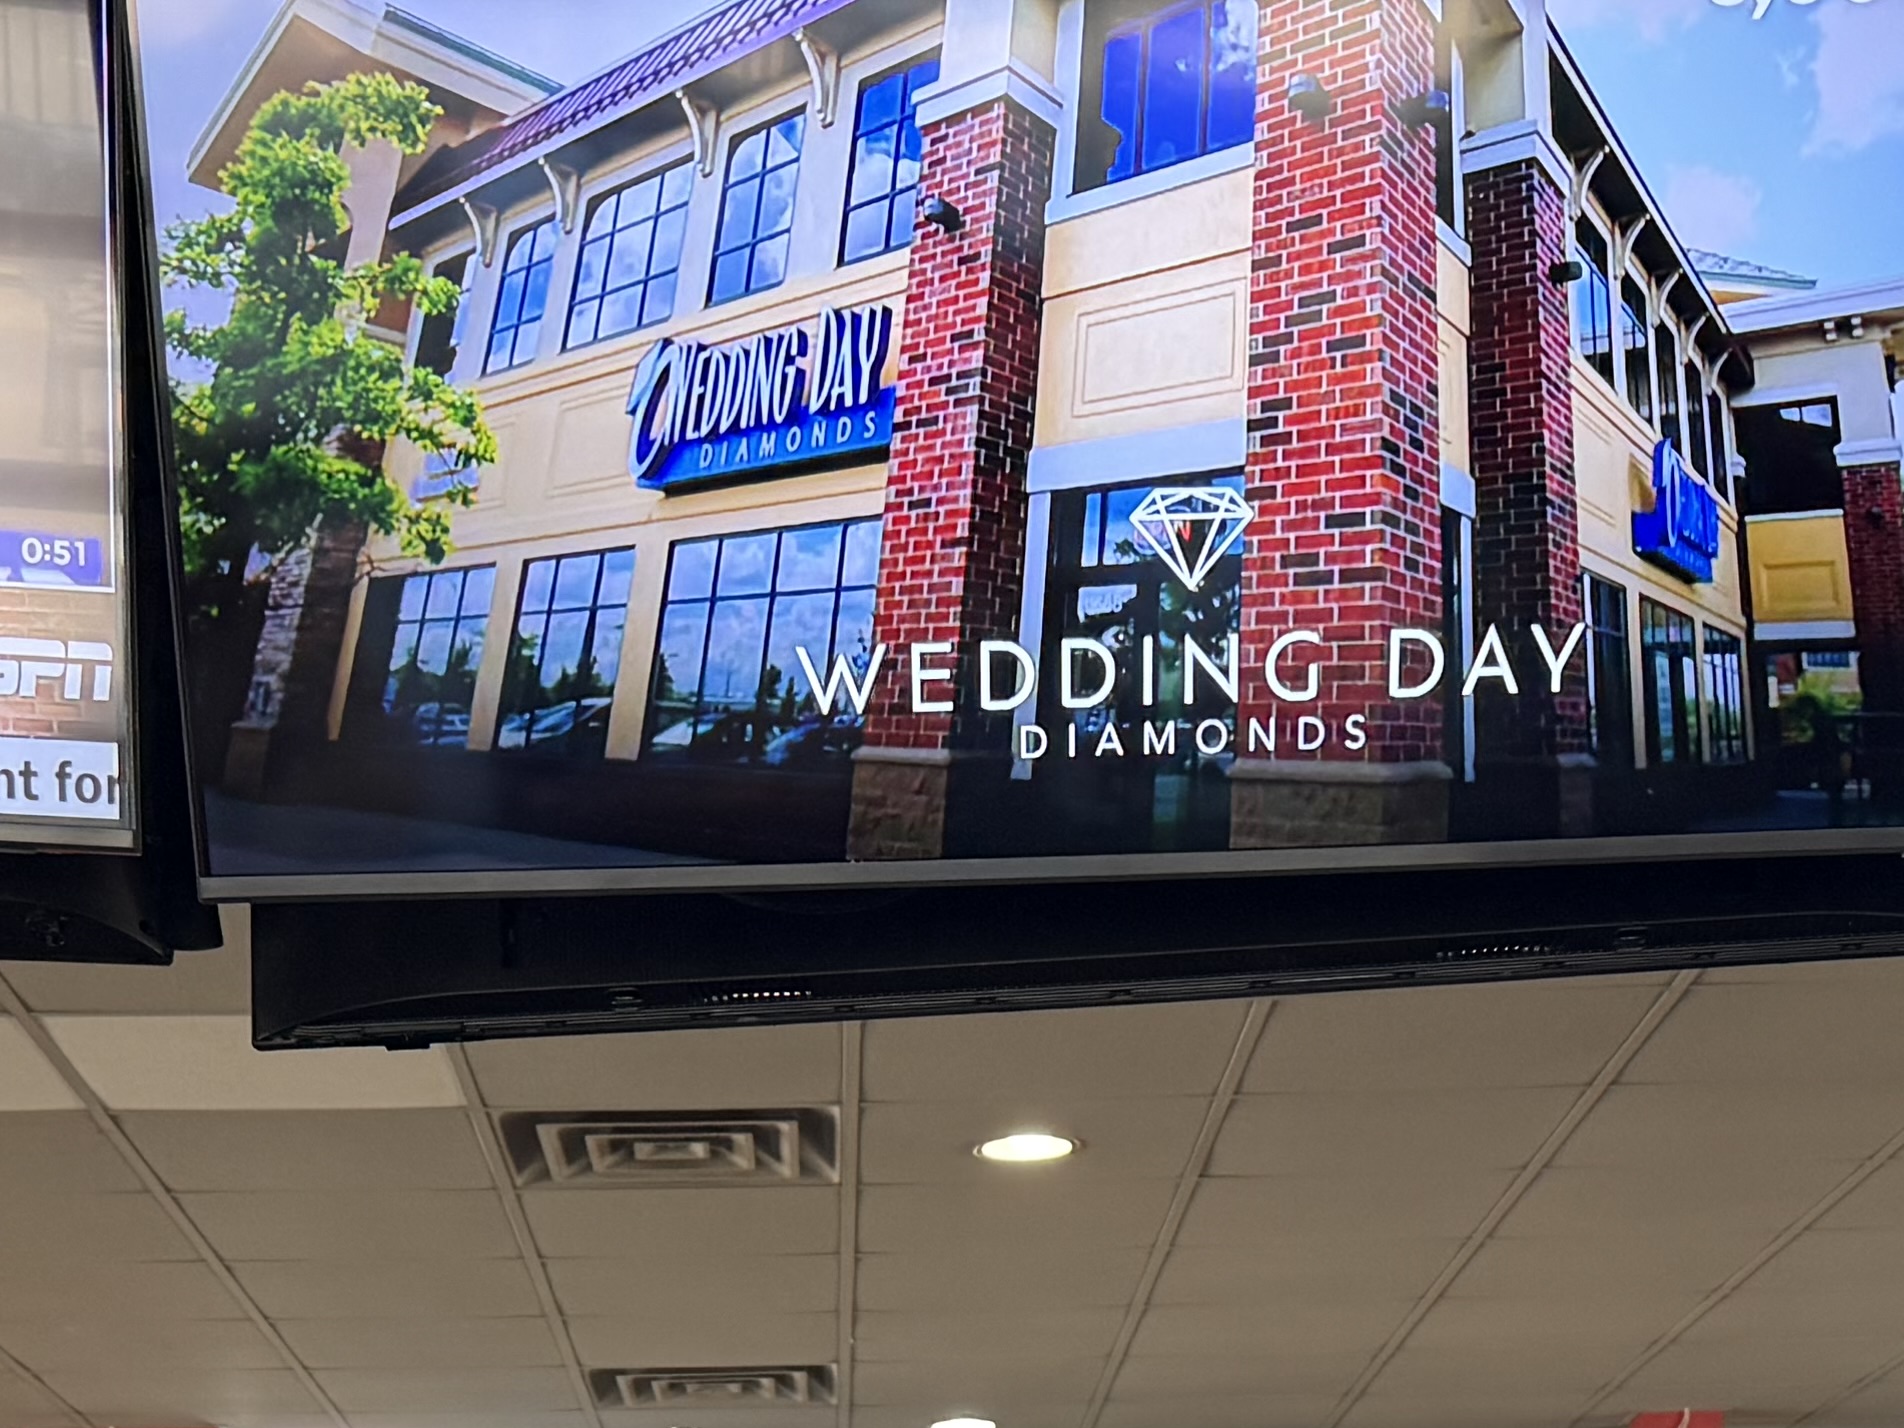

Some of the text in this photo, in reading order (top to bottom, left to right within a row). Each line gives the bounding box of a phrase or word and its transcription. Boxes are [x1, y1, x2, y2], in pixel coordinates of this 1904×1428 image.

[633, 303, 891, 487] WEDDING DAY
[697, 408, 881, 471] DIAMONDS
[19, 536, 89, 568] 0:51
[796, 621, 1591, 719] WEDDING DAY
[1017, 712, 1370, 762] DIAMONDS
[51, 755, 121, 807] for
